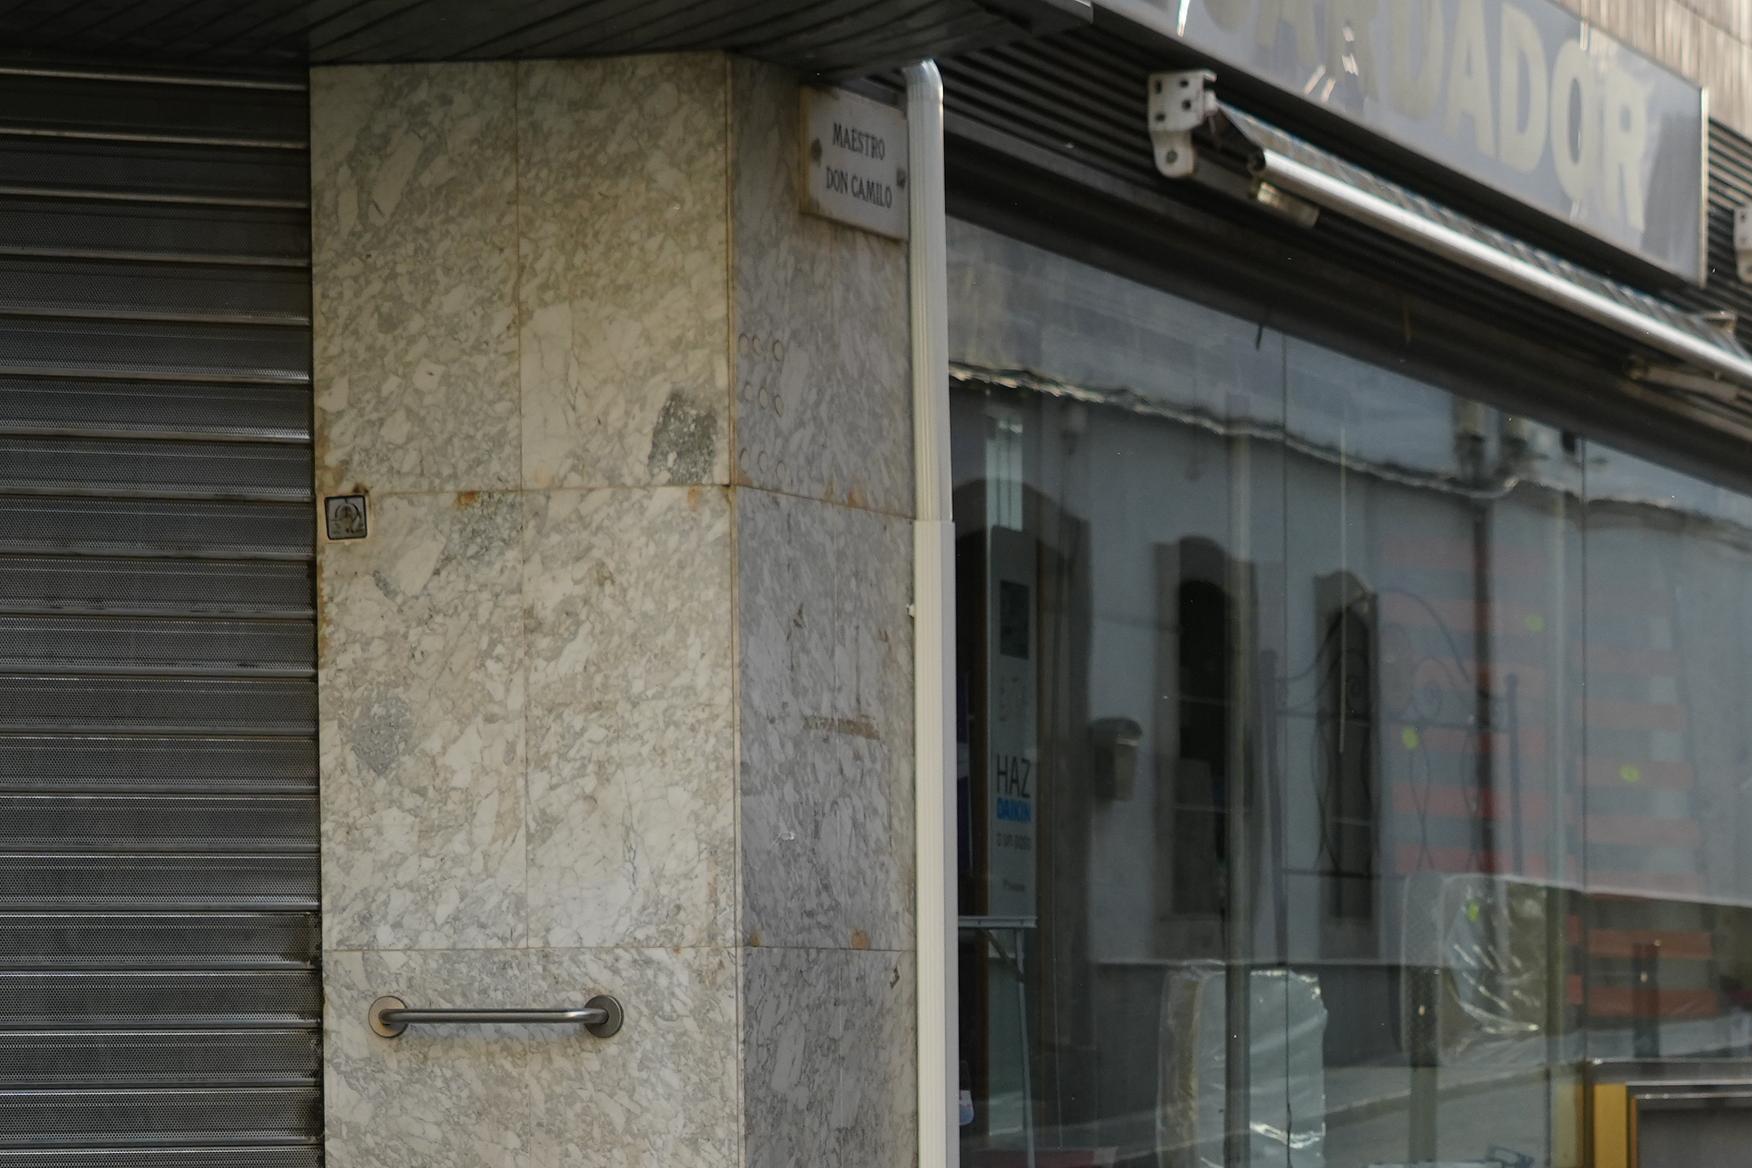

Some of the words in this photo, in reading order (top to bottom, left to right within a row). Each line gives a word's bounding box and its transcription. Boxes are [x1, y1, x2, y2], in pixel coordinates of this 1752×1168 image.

[832, 122, 886, 161] MAESTRO
[826, 166, 849, 195] DON
[851, 174, 893, 209] CAMILO
[996, 752, 1031, 798] HAZ
